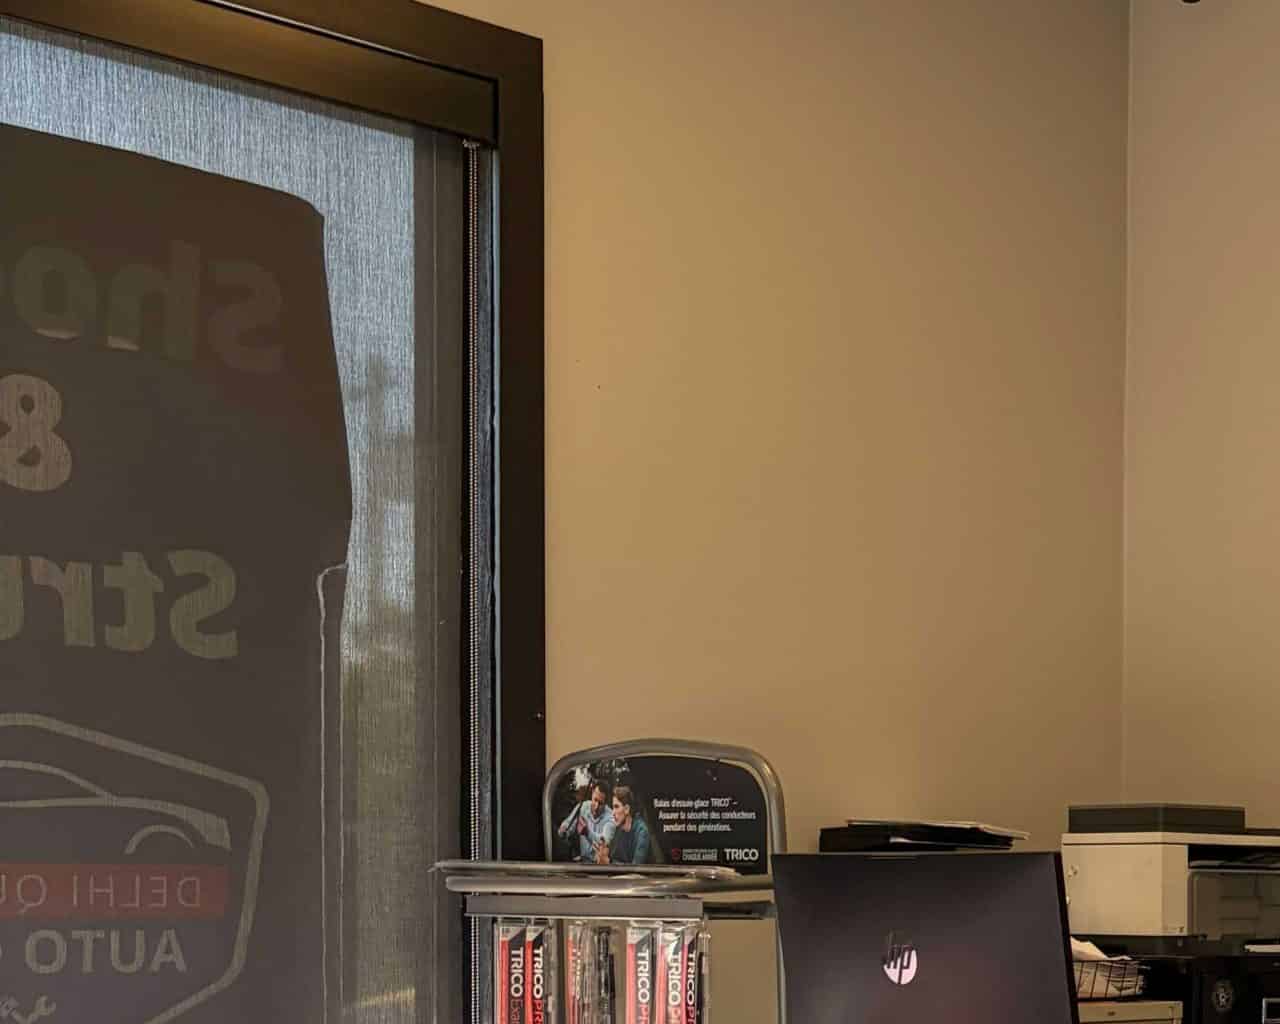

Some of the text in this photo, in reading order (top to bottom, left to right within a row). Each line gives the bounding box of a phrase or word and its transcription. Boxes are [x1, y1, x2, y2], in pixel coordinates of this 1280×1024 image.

[723, 847, 760, 862] TRICO
[510, 946, 524, 998] TRICO
[636, 948, 650, 1004] TRICO
